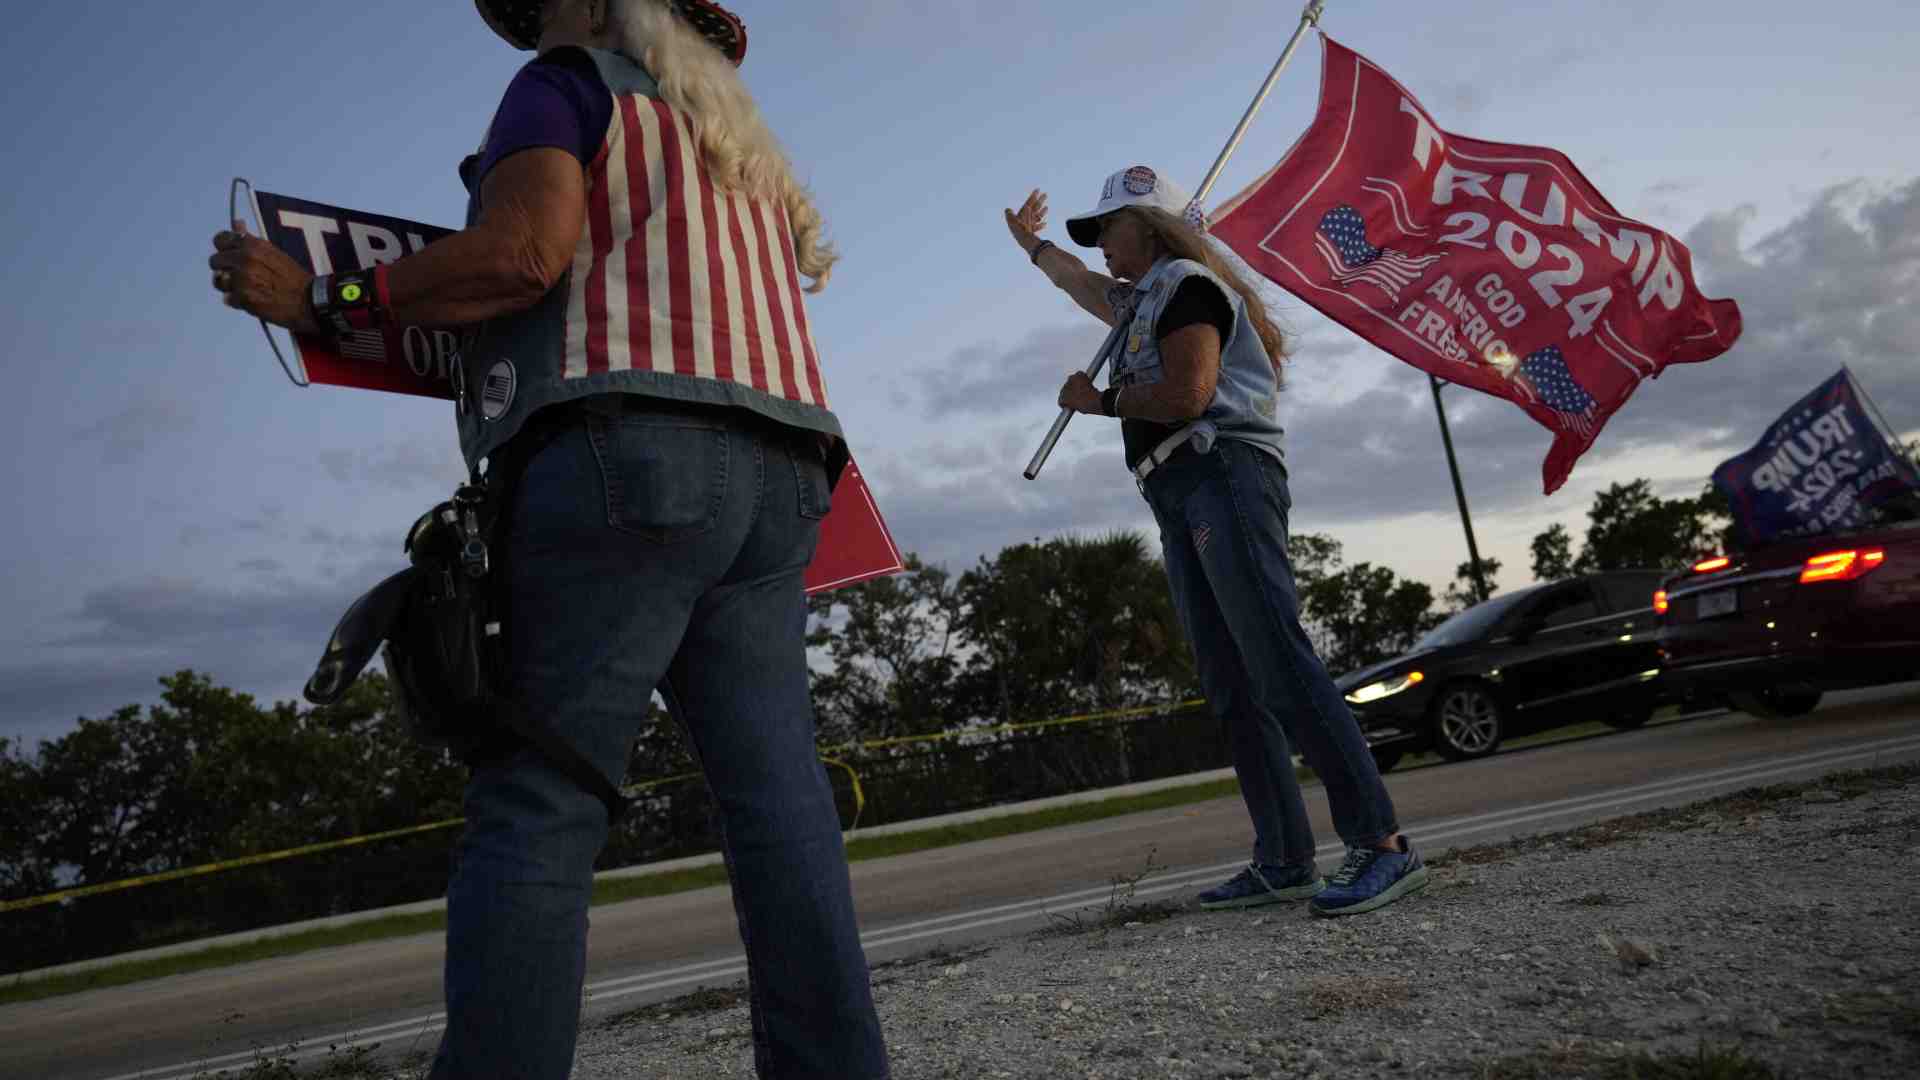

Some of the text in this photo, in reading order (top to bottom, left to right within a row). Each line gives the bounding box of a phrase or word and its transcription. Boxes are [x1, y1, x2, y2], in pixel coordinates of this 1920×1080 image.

[1400, 97, 1685, 311] TRUMP
[1438, 211, 1613, 339] 2024
[1475, 272, 1526, 328] GOD
